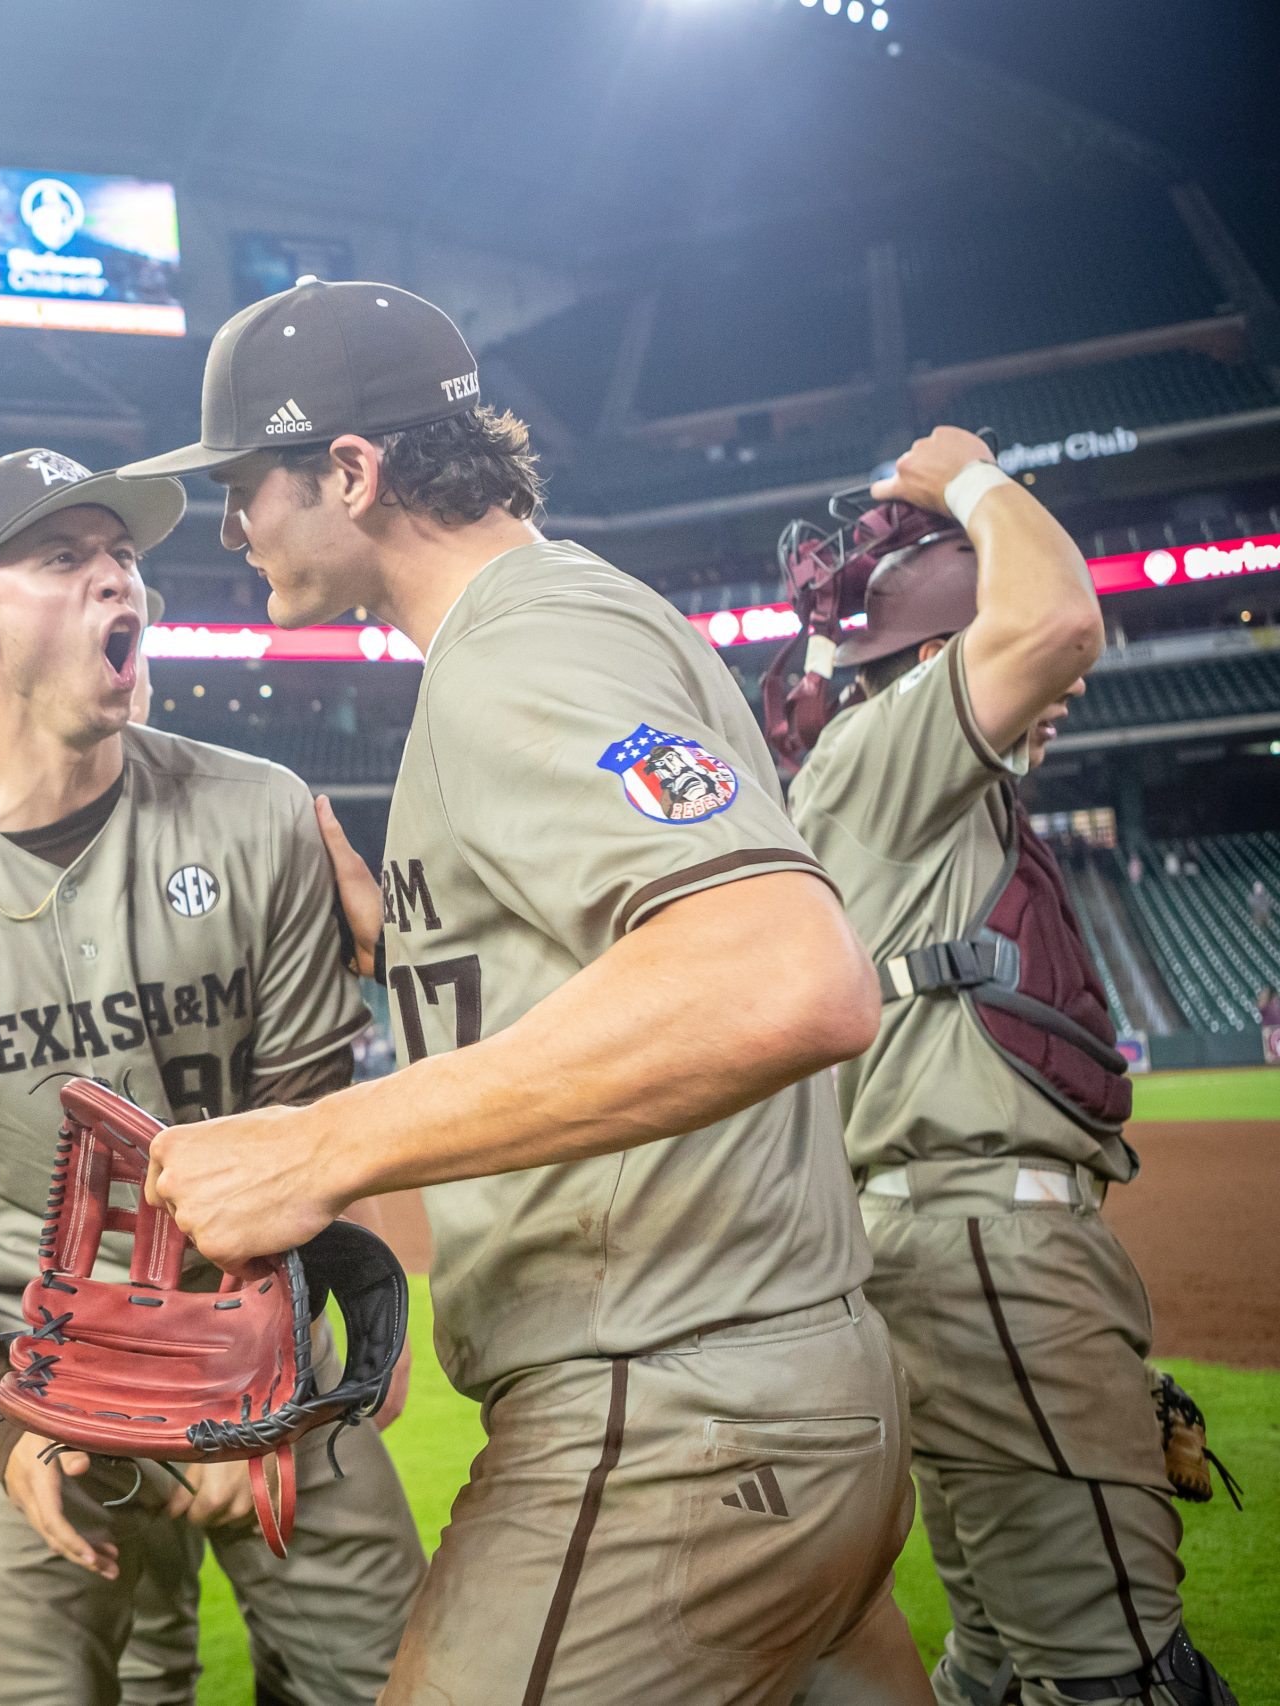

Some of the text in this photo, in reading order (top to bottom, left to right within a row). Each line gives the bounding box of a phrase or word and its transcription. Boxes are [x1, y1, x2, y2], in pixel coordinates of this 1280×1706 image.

[440, 370, 479, 402] TEXA
[265, 410, 313, 435] adidas
[1065, 426, 1138, 461] Club
[167, 865, 218, 917] SEC
[384, 859, 442, 933] &M
[138, 967, 251, 1038] A&M
[389, 954, 482, 1065] 17
